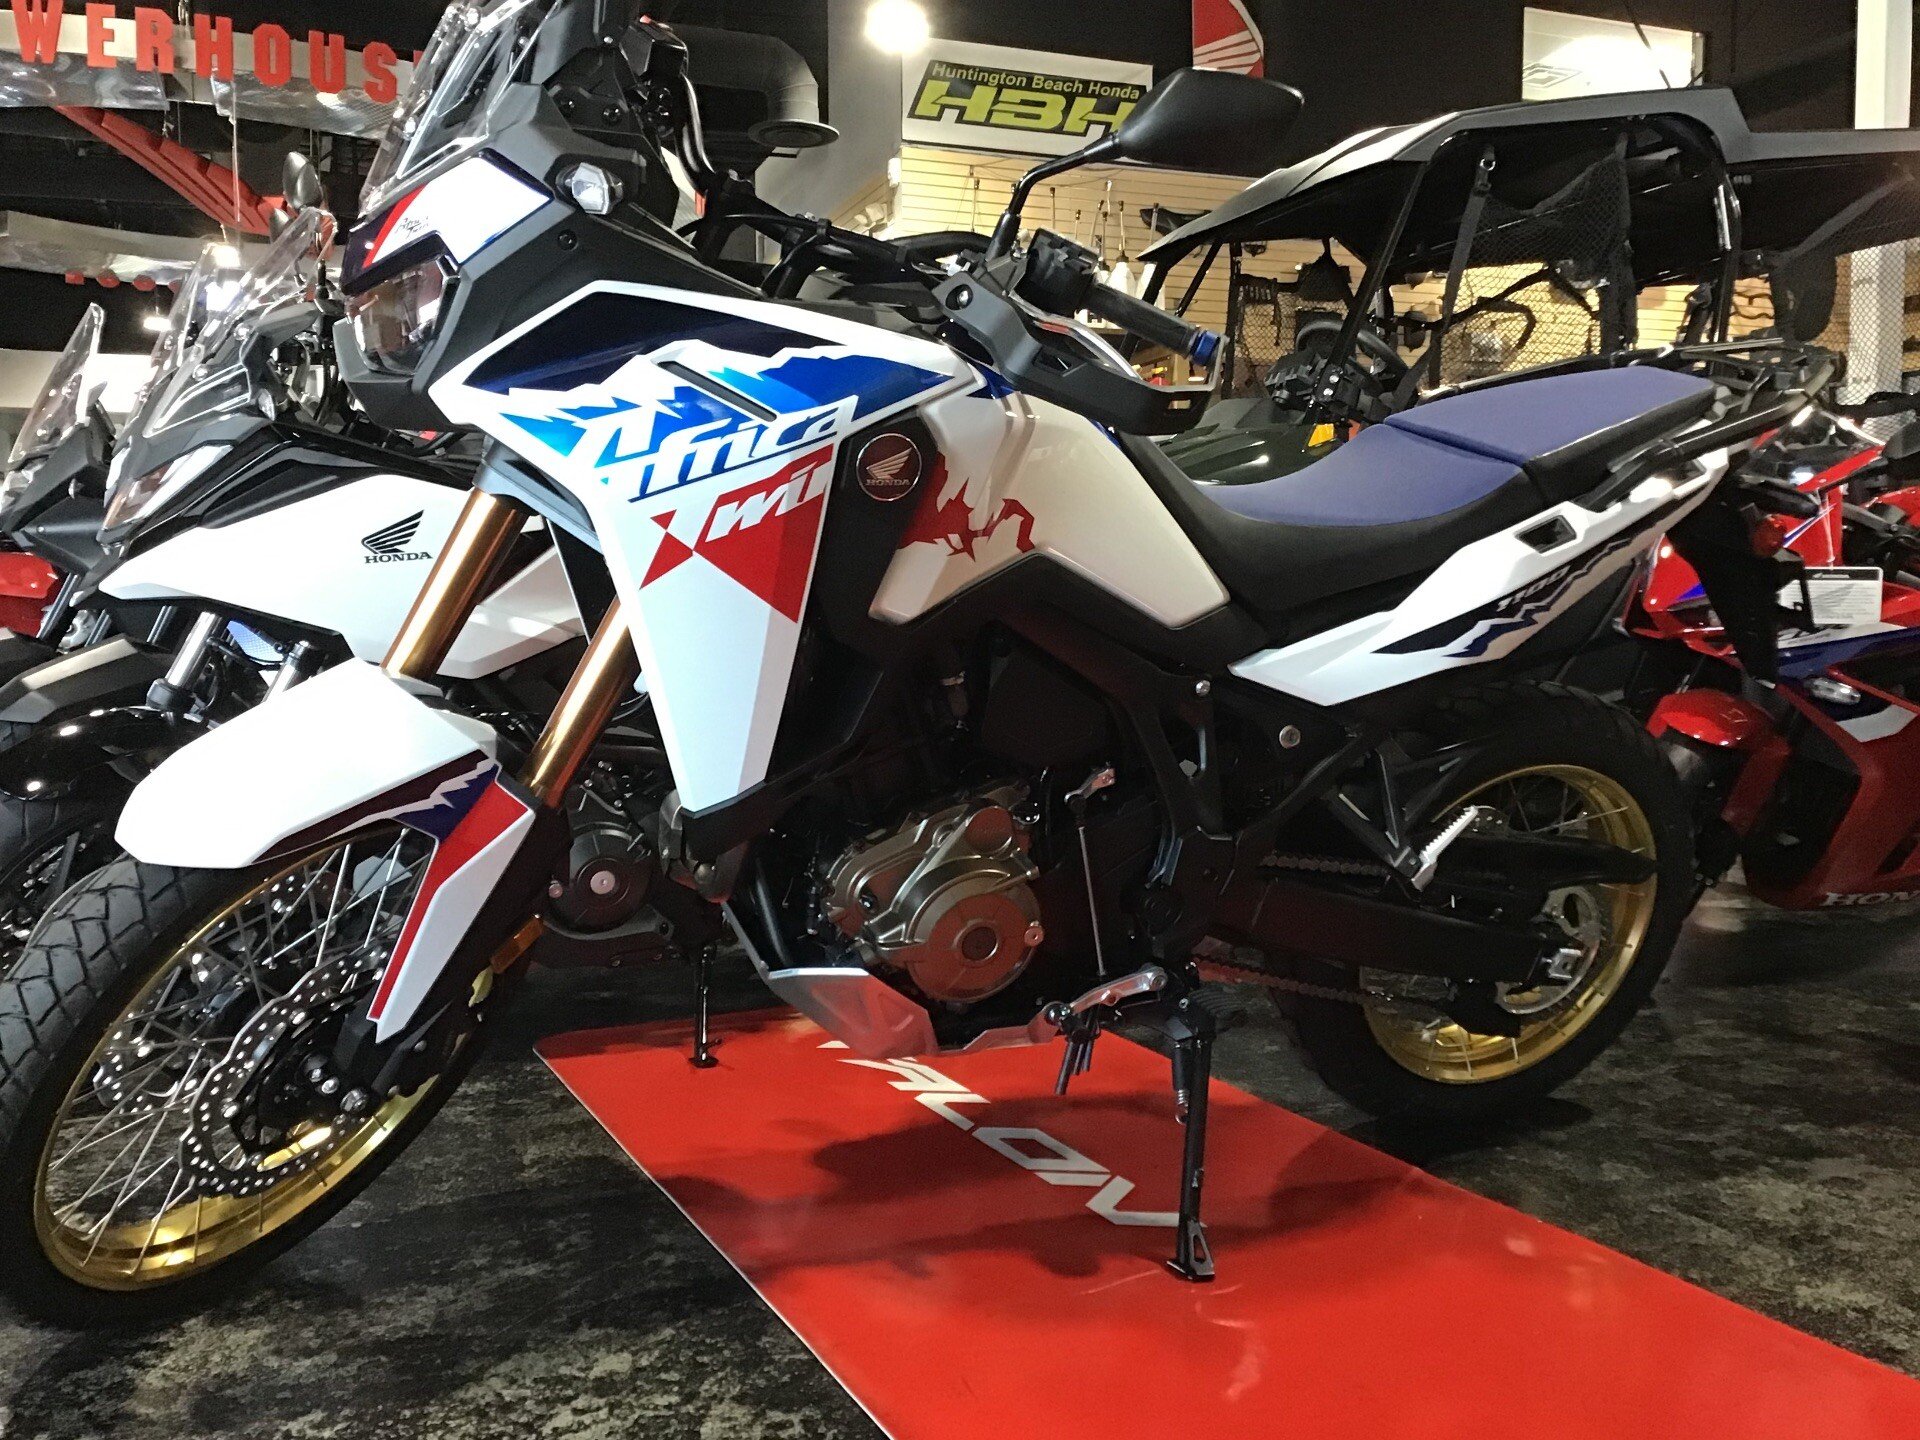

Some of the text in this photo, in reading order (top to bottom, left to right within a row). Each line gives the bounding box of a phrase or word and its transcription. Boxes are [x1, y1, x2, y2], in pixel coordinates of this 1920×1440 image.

[11, 0, 424, 104] WERHOUS
[914, 79, 1137, 135] HBH
[932, 62, 1140, 100] Huntington Beach Honda
[572, 394, 852, 502] Africa
[864, 478, 911, 487] HONDA
[364, 551, 433, 564] HONDA
[816, 1039, 1207, 1229] ALON
